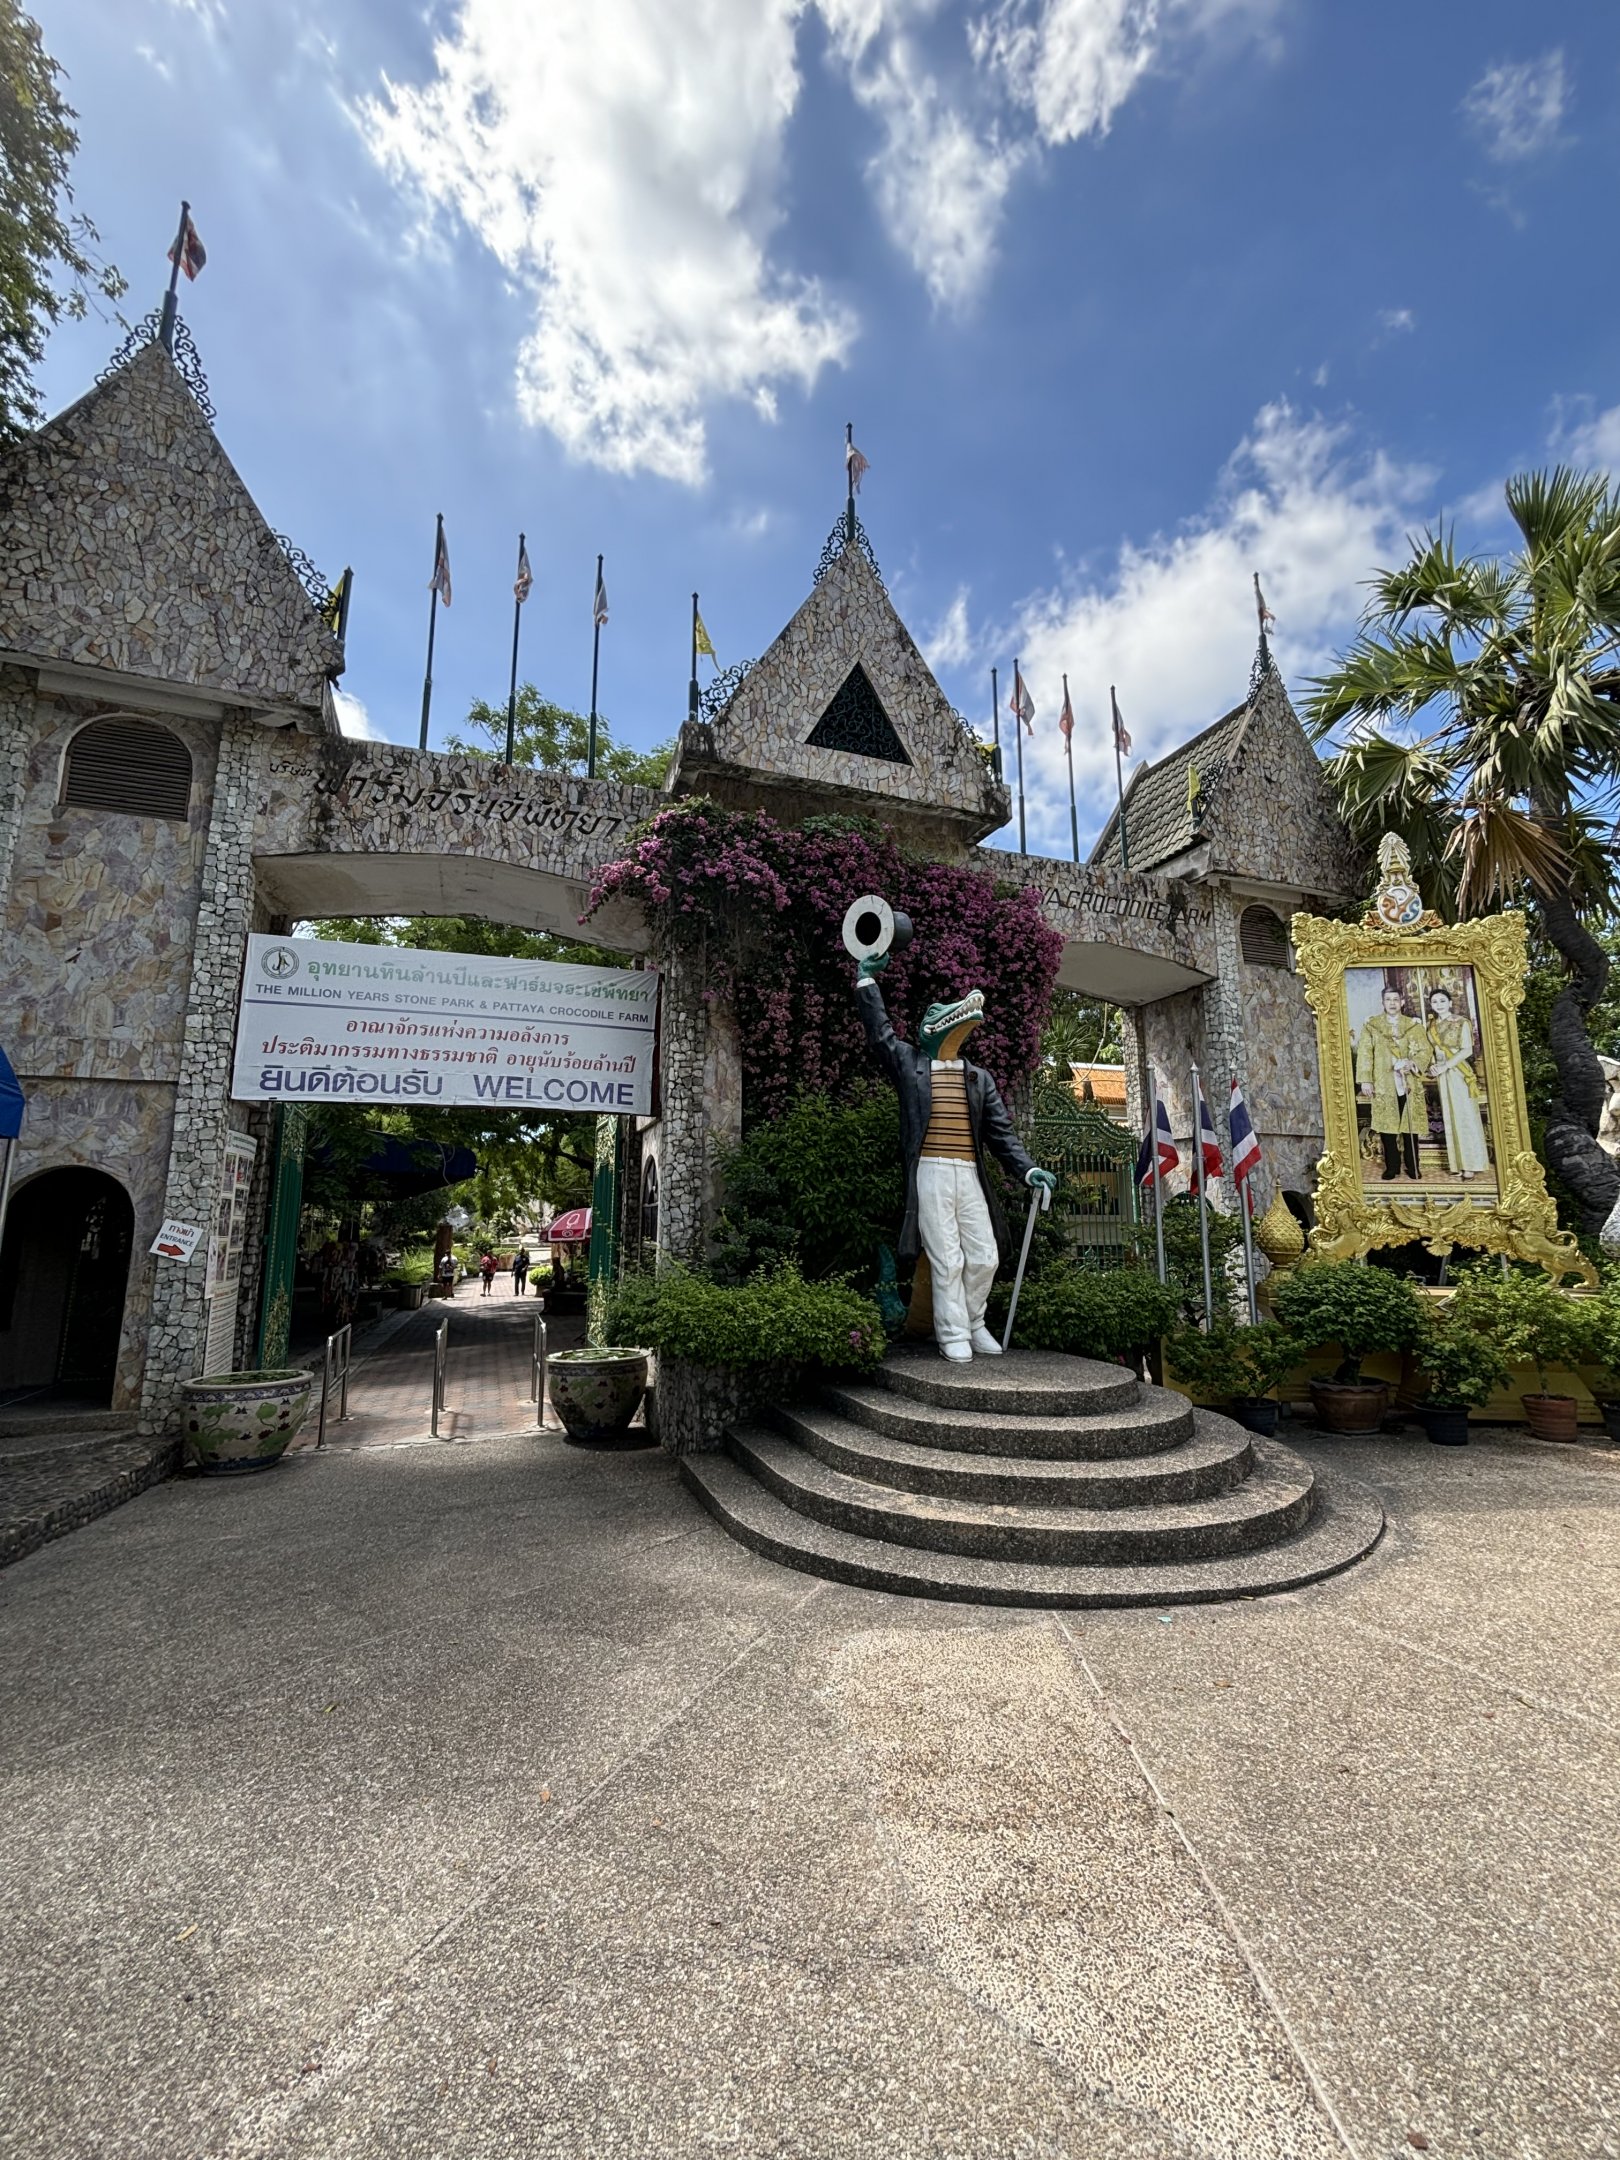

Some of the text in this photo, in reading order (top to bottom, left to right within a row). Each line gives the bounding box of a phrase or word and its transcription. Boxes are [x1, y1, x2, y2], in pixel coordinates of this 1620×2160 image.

[1066, 890, 1167, 921] CROCODILE
[1168, 904, 1211, 928] FARM
[255, 983, 649, 1023] THE MILLION YEARS STONE PARK & PATTAYA CROCODILE FARM
[346, 1016, 570, 1046] อาณาจักรแห่งความอลังการ
[261, 1034, 637, 1074] ประติมากรรมทางธรรมชาติ อายุนับร้อยล้านปี
[259, 1064, 443, 1096] ยินดีต้อนรับ
[473, 1074, 635, 1106] WELCOME
[160, 1232, 194, 1248] ENTRANCE
